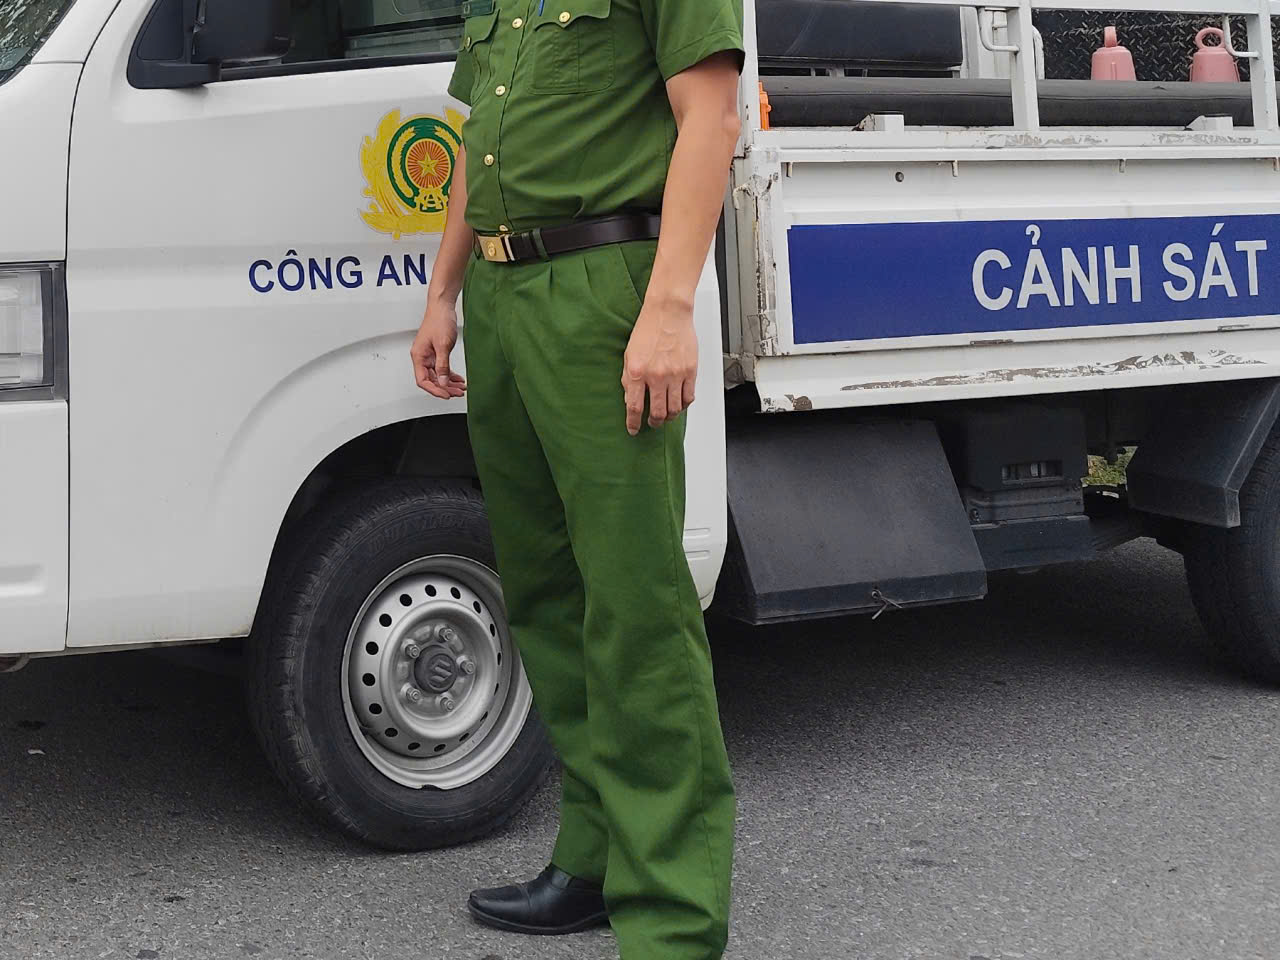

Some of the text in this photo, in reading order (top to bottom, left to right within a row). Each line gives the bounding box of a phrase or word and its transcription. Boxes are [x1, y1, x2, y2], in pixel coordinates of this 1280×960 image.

[248, 249, 427, 293] CÔNG AN
[972, 223, 1267, 311] CẢNH SÁT
